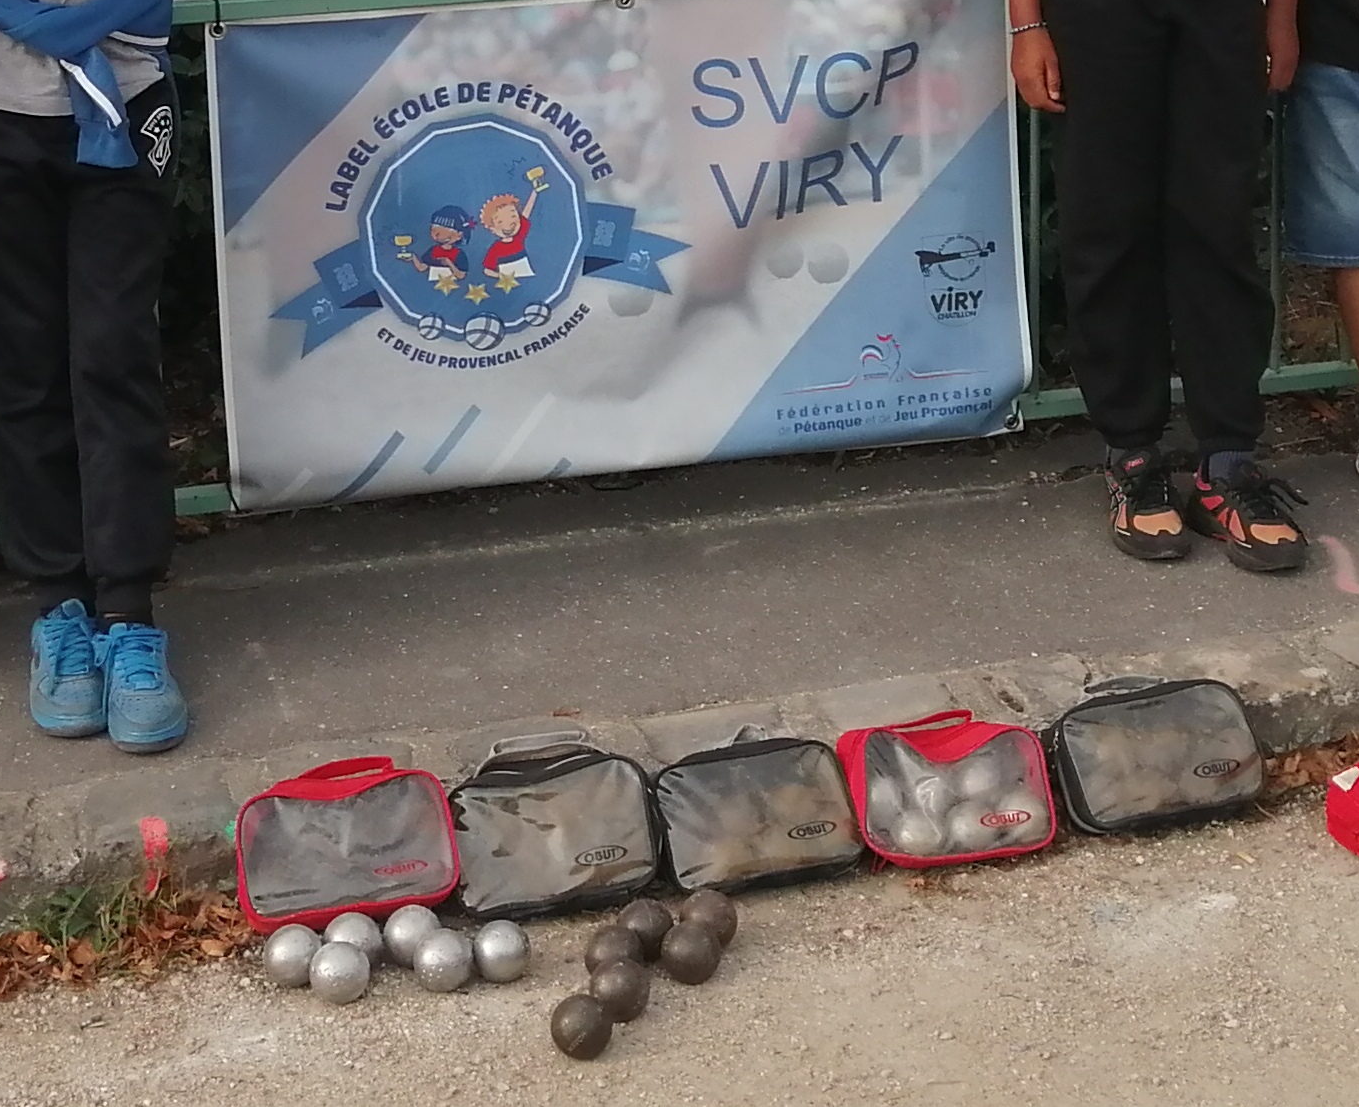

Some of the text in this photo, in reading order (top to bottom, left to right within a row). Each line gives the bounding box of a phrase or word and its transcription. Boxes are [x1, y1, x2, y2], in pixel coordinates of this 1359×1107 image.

[691, 41, 920, 129] SVCP
[325, 81, 614, 213] LABEL ÉCOLE DE PÉTANQUE
[709, 134, 904, 229] VIRY
[376, 327, 394, 344] ET
[393, 336, 411, 355] DE
[410, 348, 436, 364] JEU
[524, 303, 591, 356] FRANÇAISE
[776, 386, 992, 420] Fédération Française
[794, 417, 862, 434] Pétanque
[894, 408, 918, 422] Jeu
[921, 399, 993, 419] Provençal
[1202, 762, 1231, 775] OBUT
[796, 823, 827, 837] OBUT
[988, 812, 1022, 825] OBUT
[584, 849, 618, 864] OBUT
